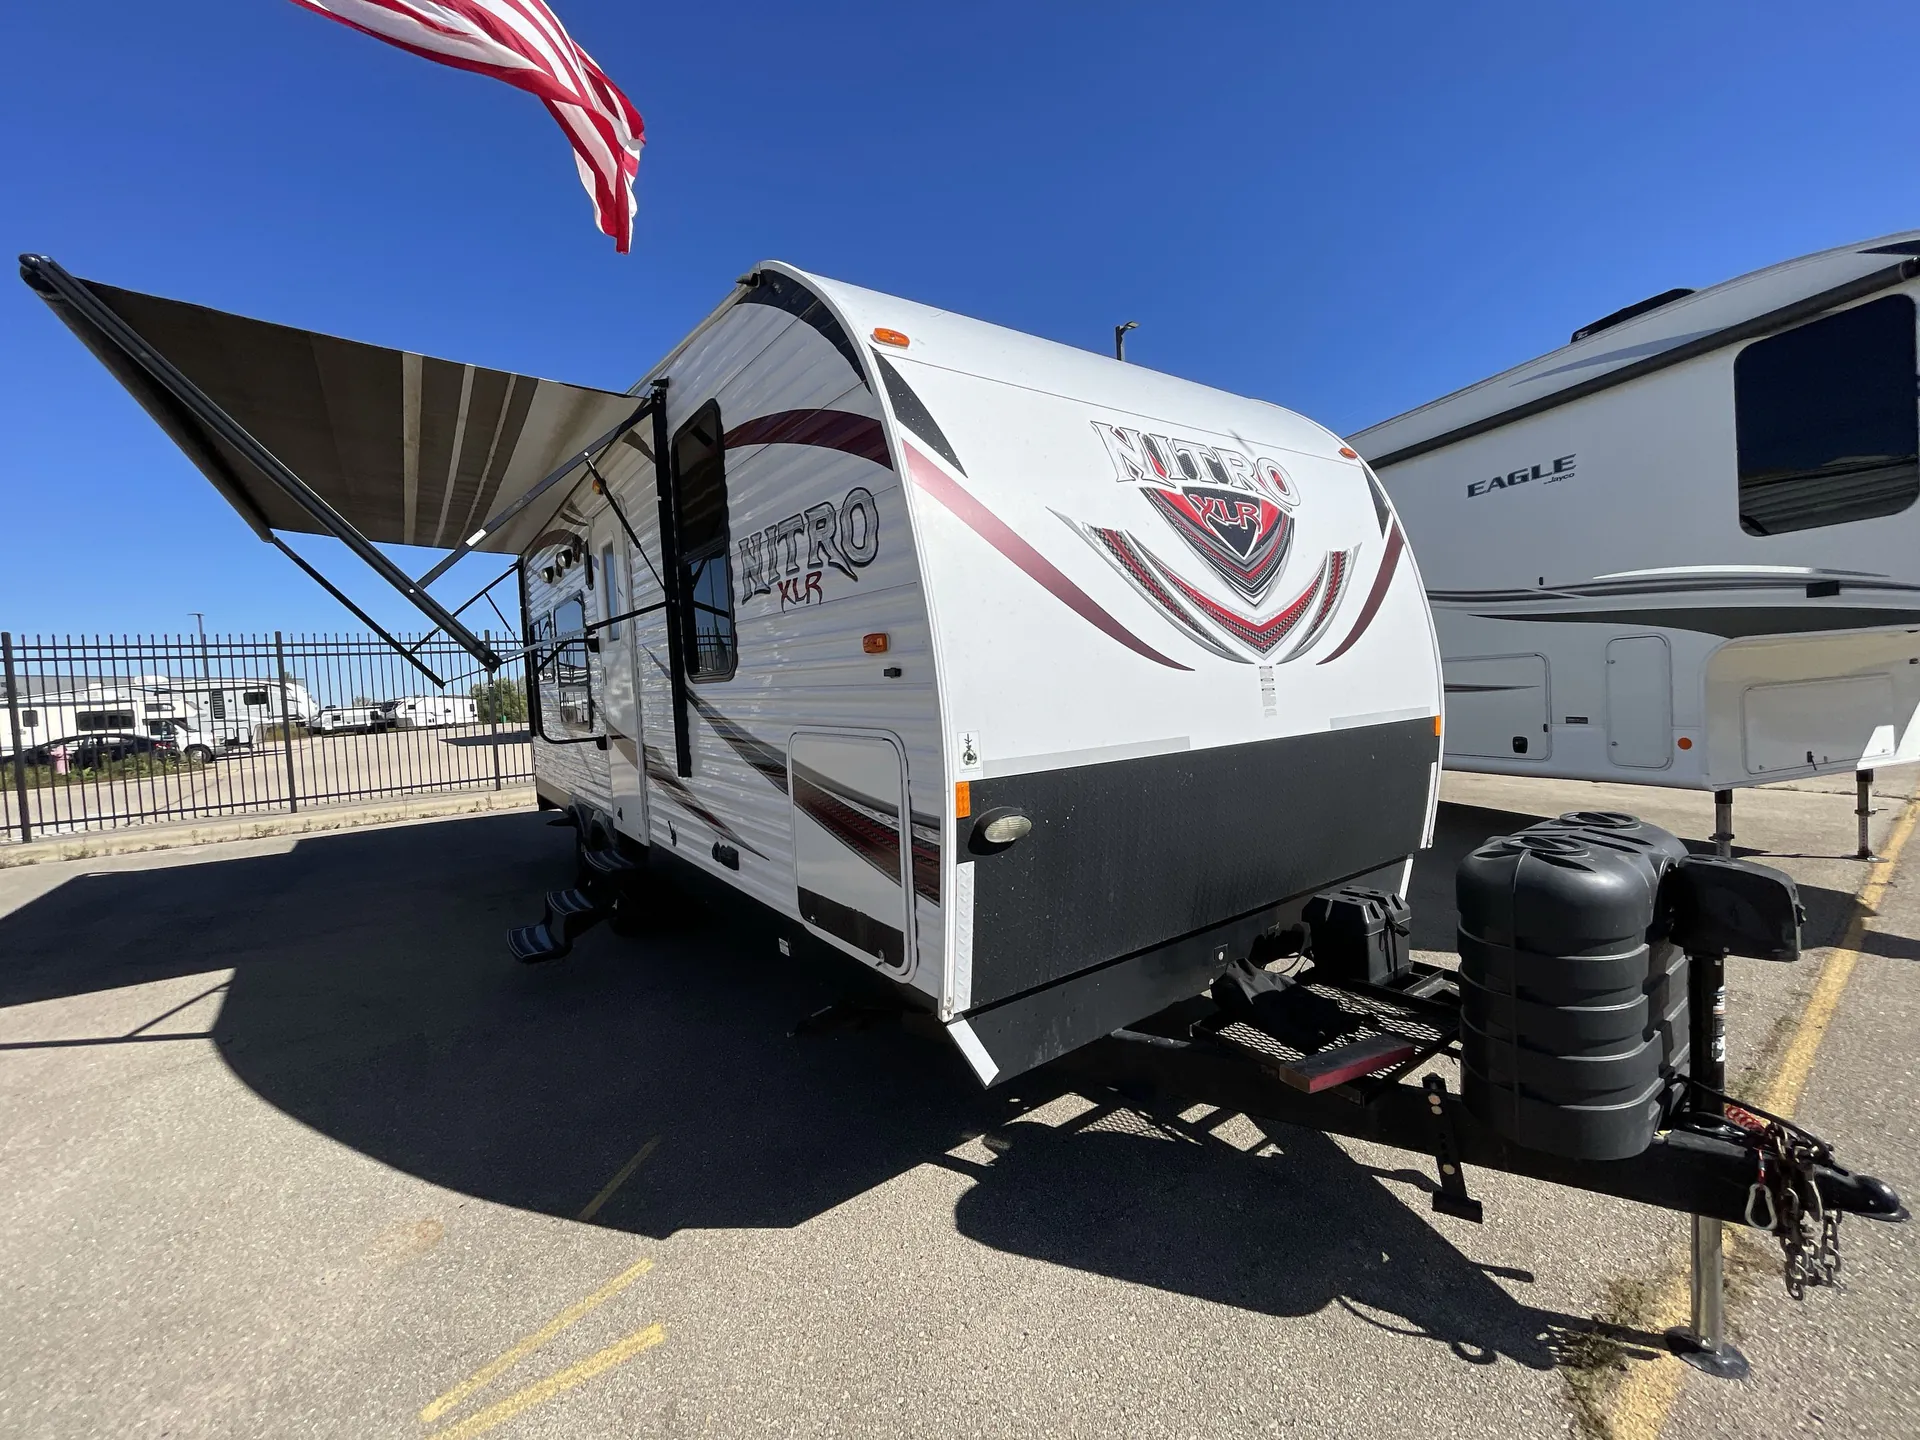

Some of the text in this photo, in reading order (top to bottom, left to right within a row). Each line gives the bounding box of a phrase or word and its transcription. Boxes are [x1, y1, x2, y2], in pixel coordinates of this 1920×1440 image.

[1090, 420, 1301, 512] NITRO
[1466, 453, 1577, 499] EAGLE
[1543, 472, 1575, 485] Jayco
[1189, 494, 1262, 532] XLR
[738, 487, 880, 605] NITRO
[777, 571, 823, 614] XLR
